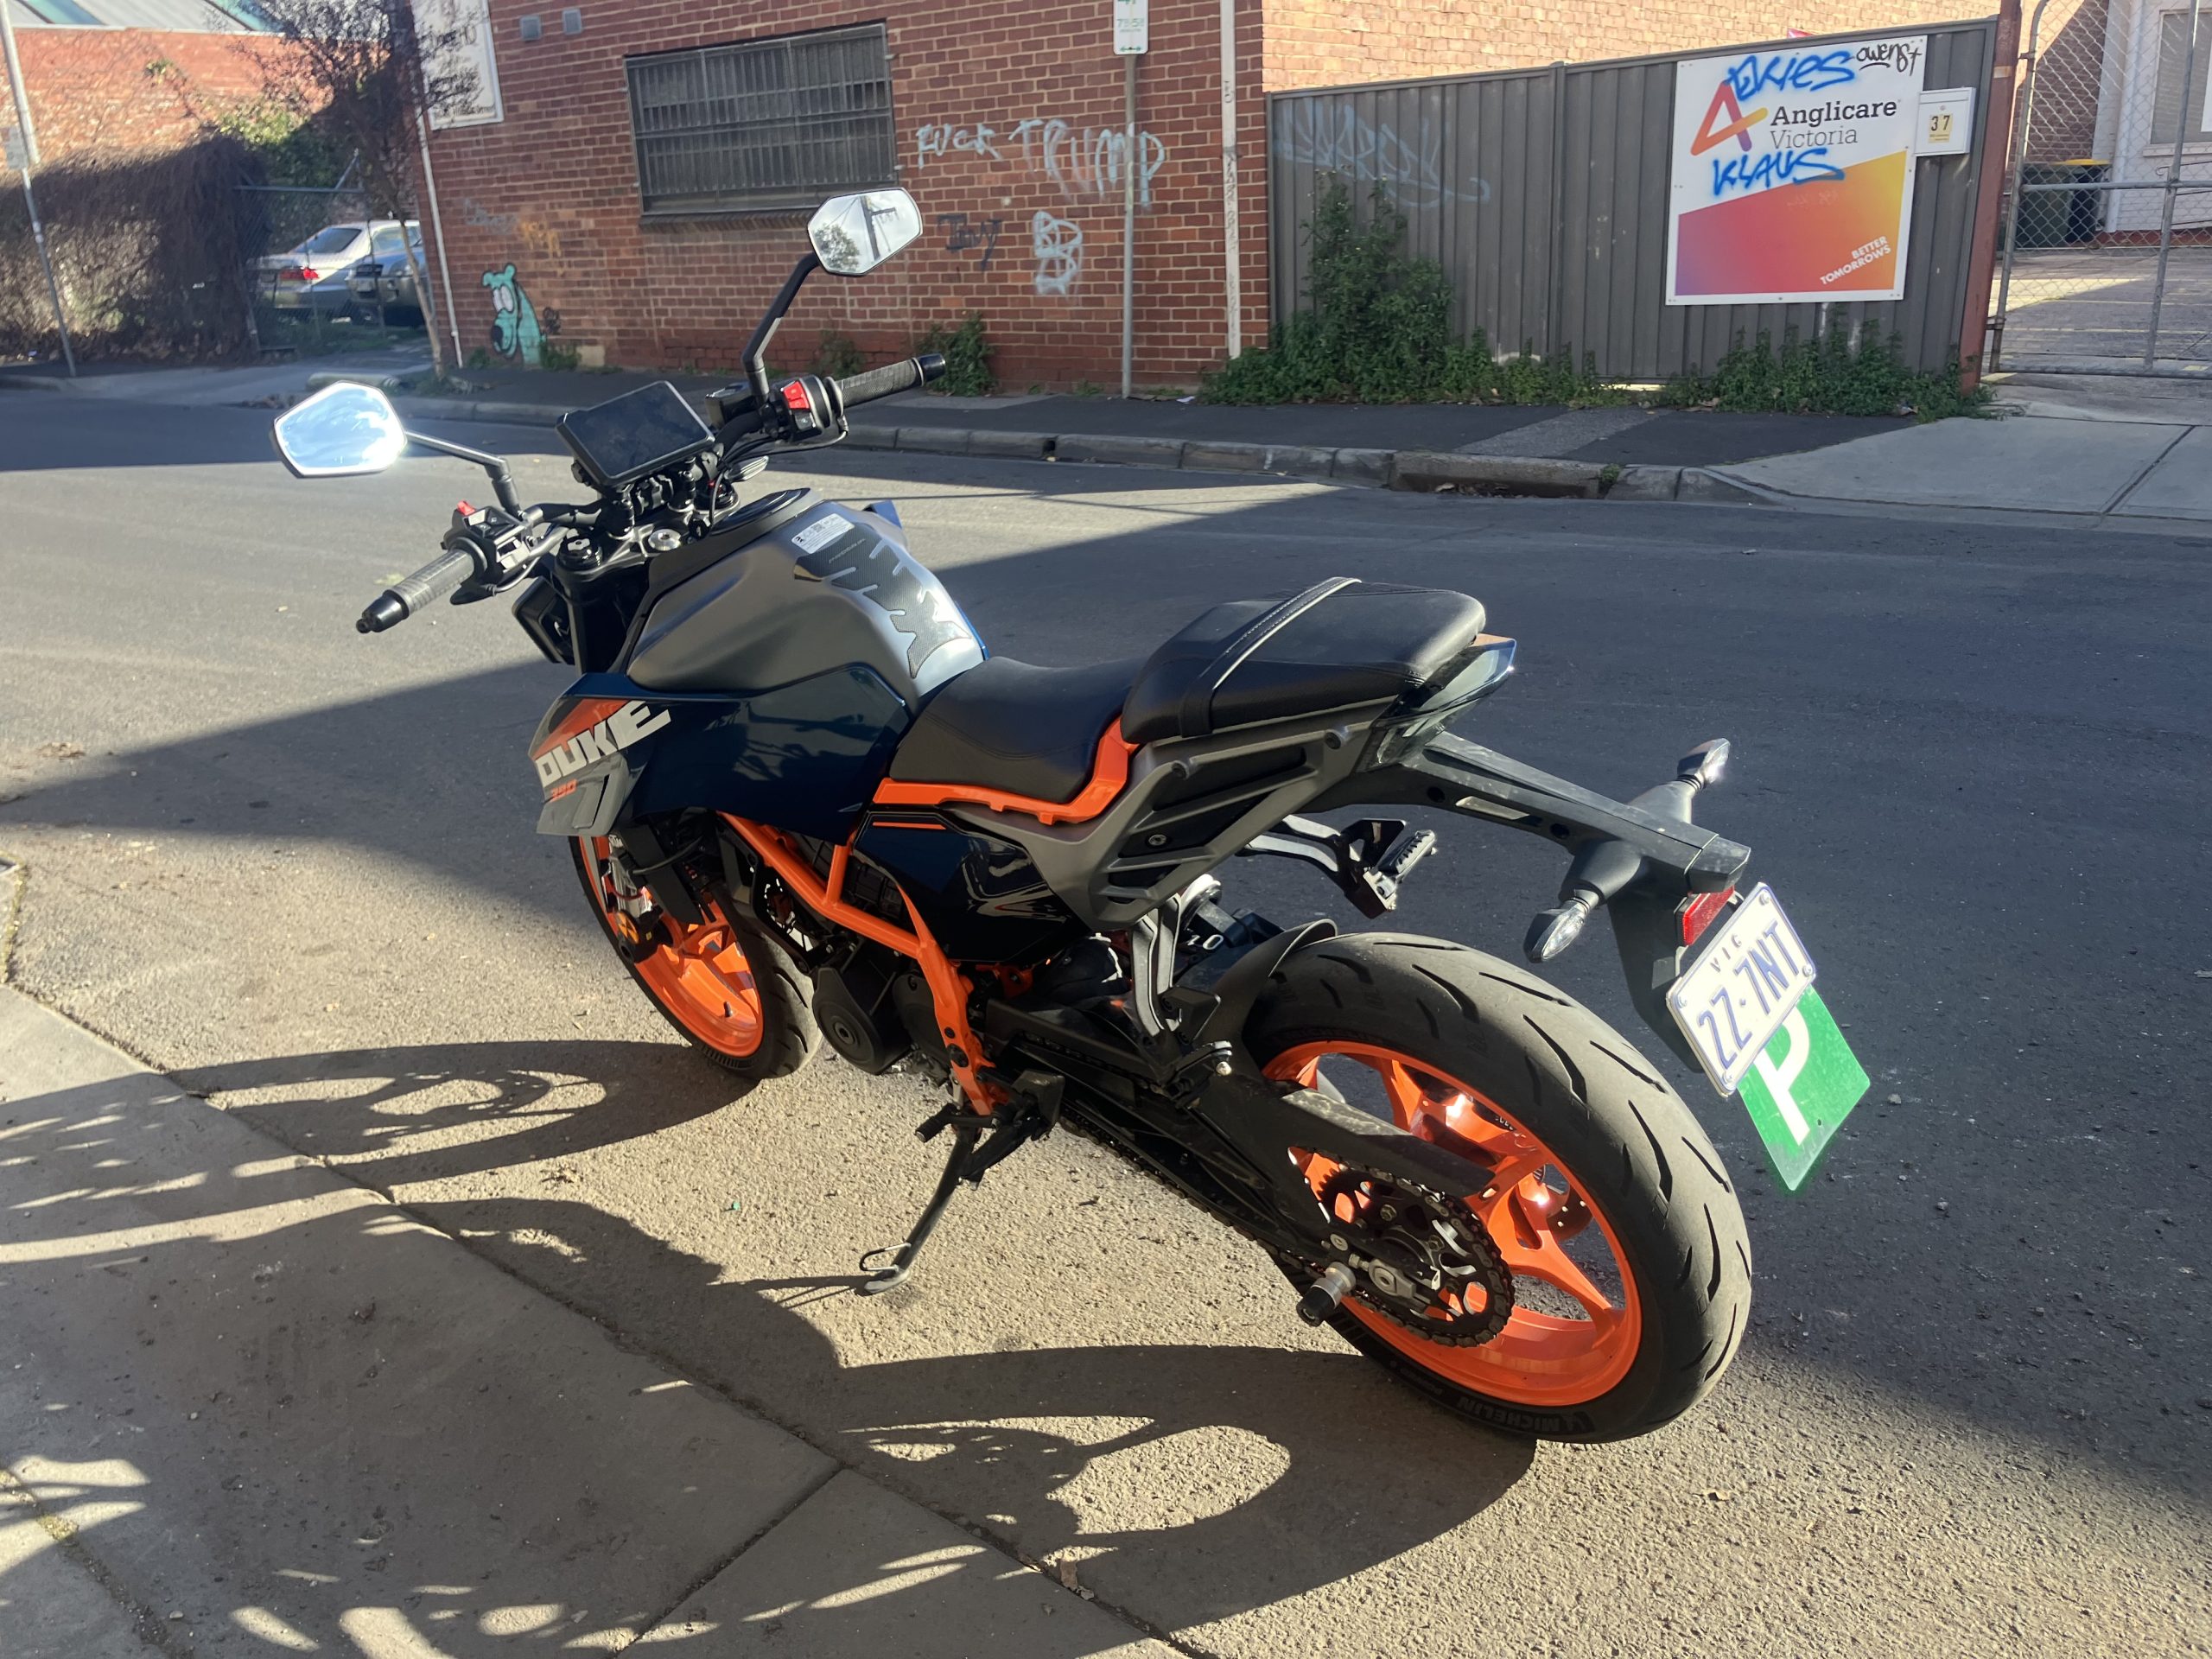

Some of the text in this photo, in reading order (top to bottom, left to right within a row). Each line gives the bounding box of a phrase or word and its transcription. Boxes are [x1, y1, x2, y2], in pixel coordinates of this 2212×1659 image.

[1770, 100, 1897, 127] Anglicare
[1930, 115, 1950, 131] 37
[1770, 125, 1859, 149] Victoria
[1851, 236, 1888, 259] BETTER
[1820, 245, 1891, 285] TOMORROWS
[535, 699, 671, 788] DUKE
[1710, 933, 1742, 972] VIC
